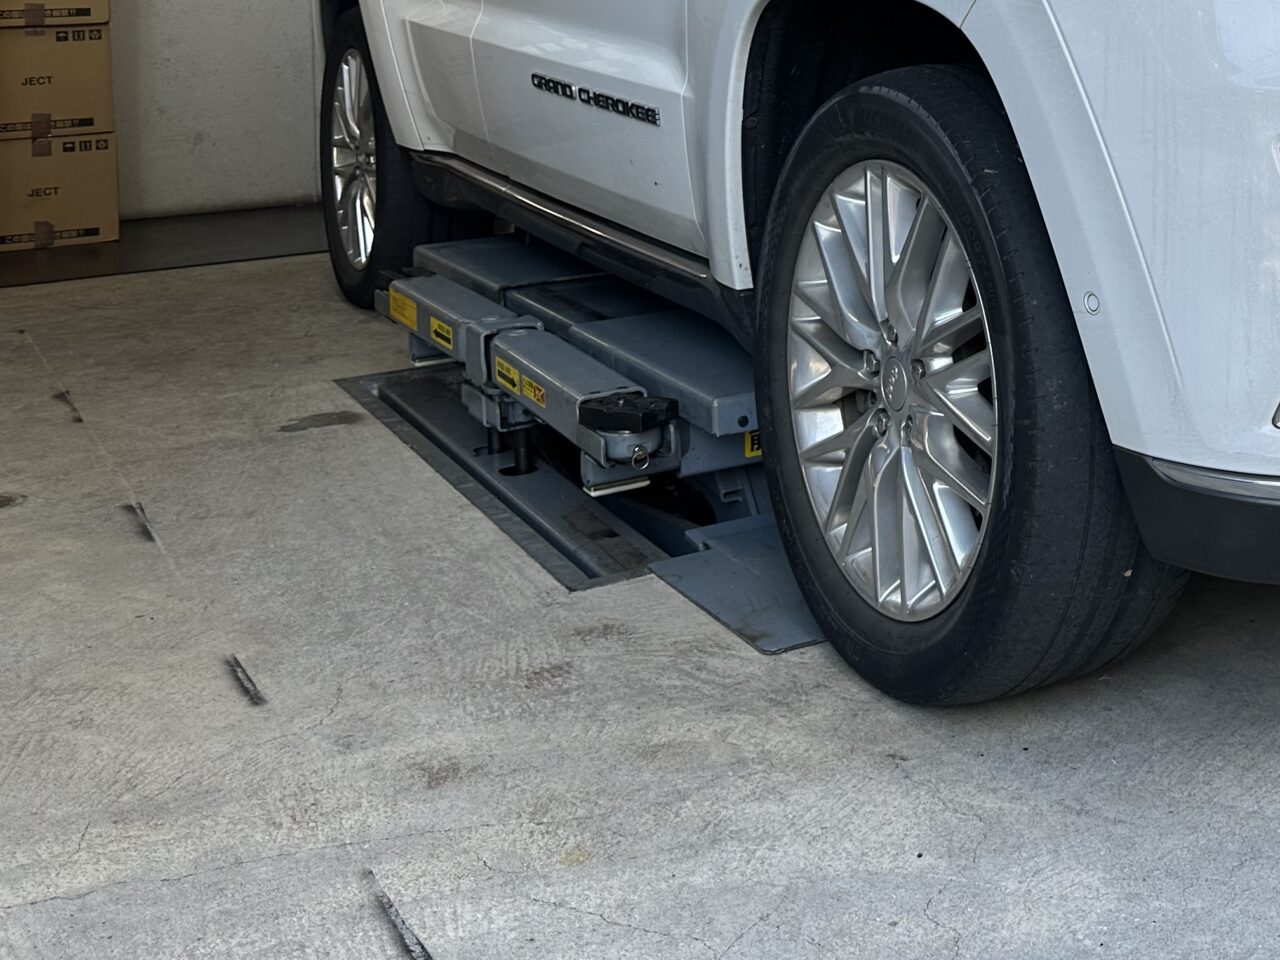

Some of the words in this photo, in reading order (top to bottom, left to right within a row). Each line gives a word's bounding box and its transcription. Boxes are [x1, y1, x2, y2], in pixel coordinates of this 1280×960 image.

[21, 76, 54, 86] JECT
[531, 72, 577, 101] GRAND
[578, 86, 661, 127] CHEROKEE
[27, 186, 60, 197] JECT
